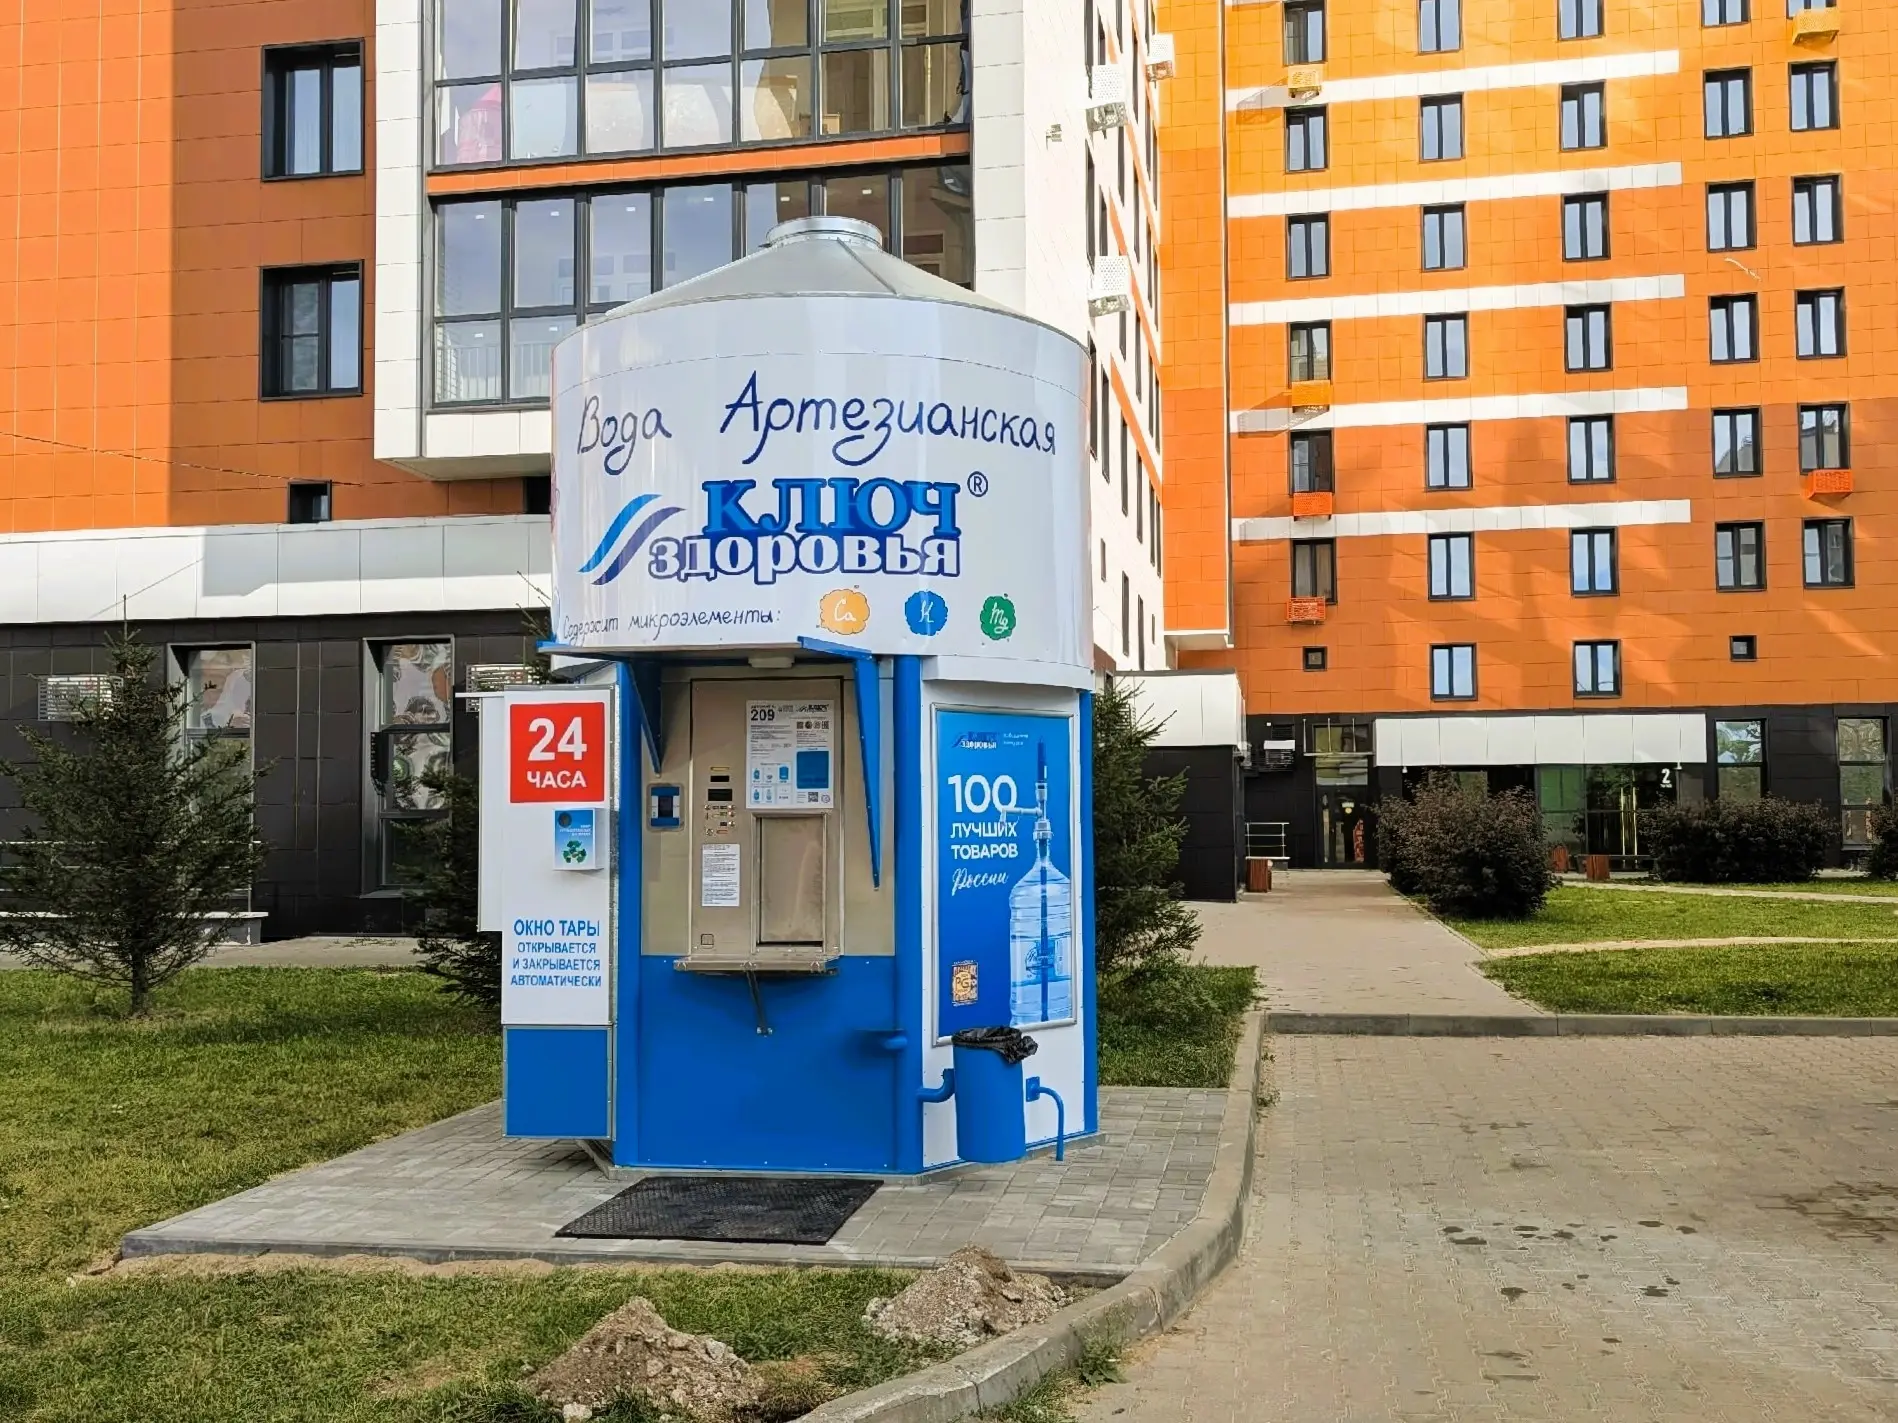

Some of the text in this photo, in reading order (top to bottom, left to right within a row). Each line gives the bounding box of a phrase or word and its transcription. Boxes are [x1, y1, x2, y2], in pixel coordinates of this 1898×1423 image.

[577, 370, 1057, 476] Вода Артезианская
[702, 477, 961, 537] КЛЮЧ
[563, 609, 781, 647] Содержит микроэлементы:
[750, 708, 775, 721] 209
[527, 716, 588, 761] 24
[526, 770, 588, 789] ЧАСА
[1661, 768, 1671, 784] 2
[947, 774, 1018, 814] 100
[950, 821, 1018, 838] ЛУЧШИХ
[951, 843, 1019, 860] ТОВАРОВ
[951, 867, 1009, 896] России
[513, 919, 600, 937] ОКНО ТАРЫ
[517, 942, 596, 954] ОТКРЫВАЕТСЯ
[512, 958, 601, 971] И ЗАКРЫВАЕТСЯ
[510, 975, 602, 987] АВТОМАТИЧЕСКИ
